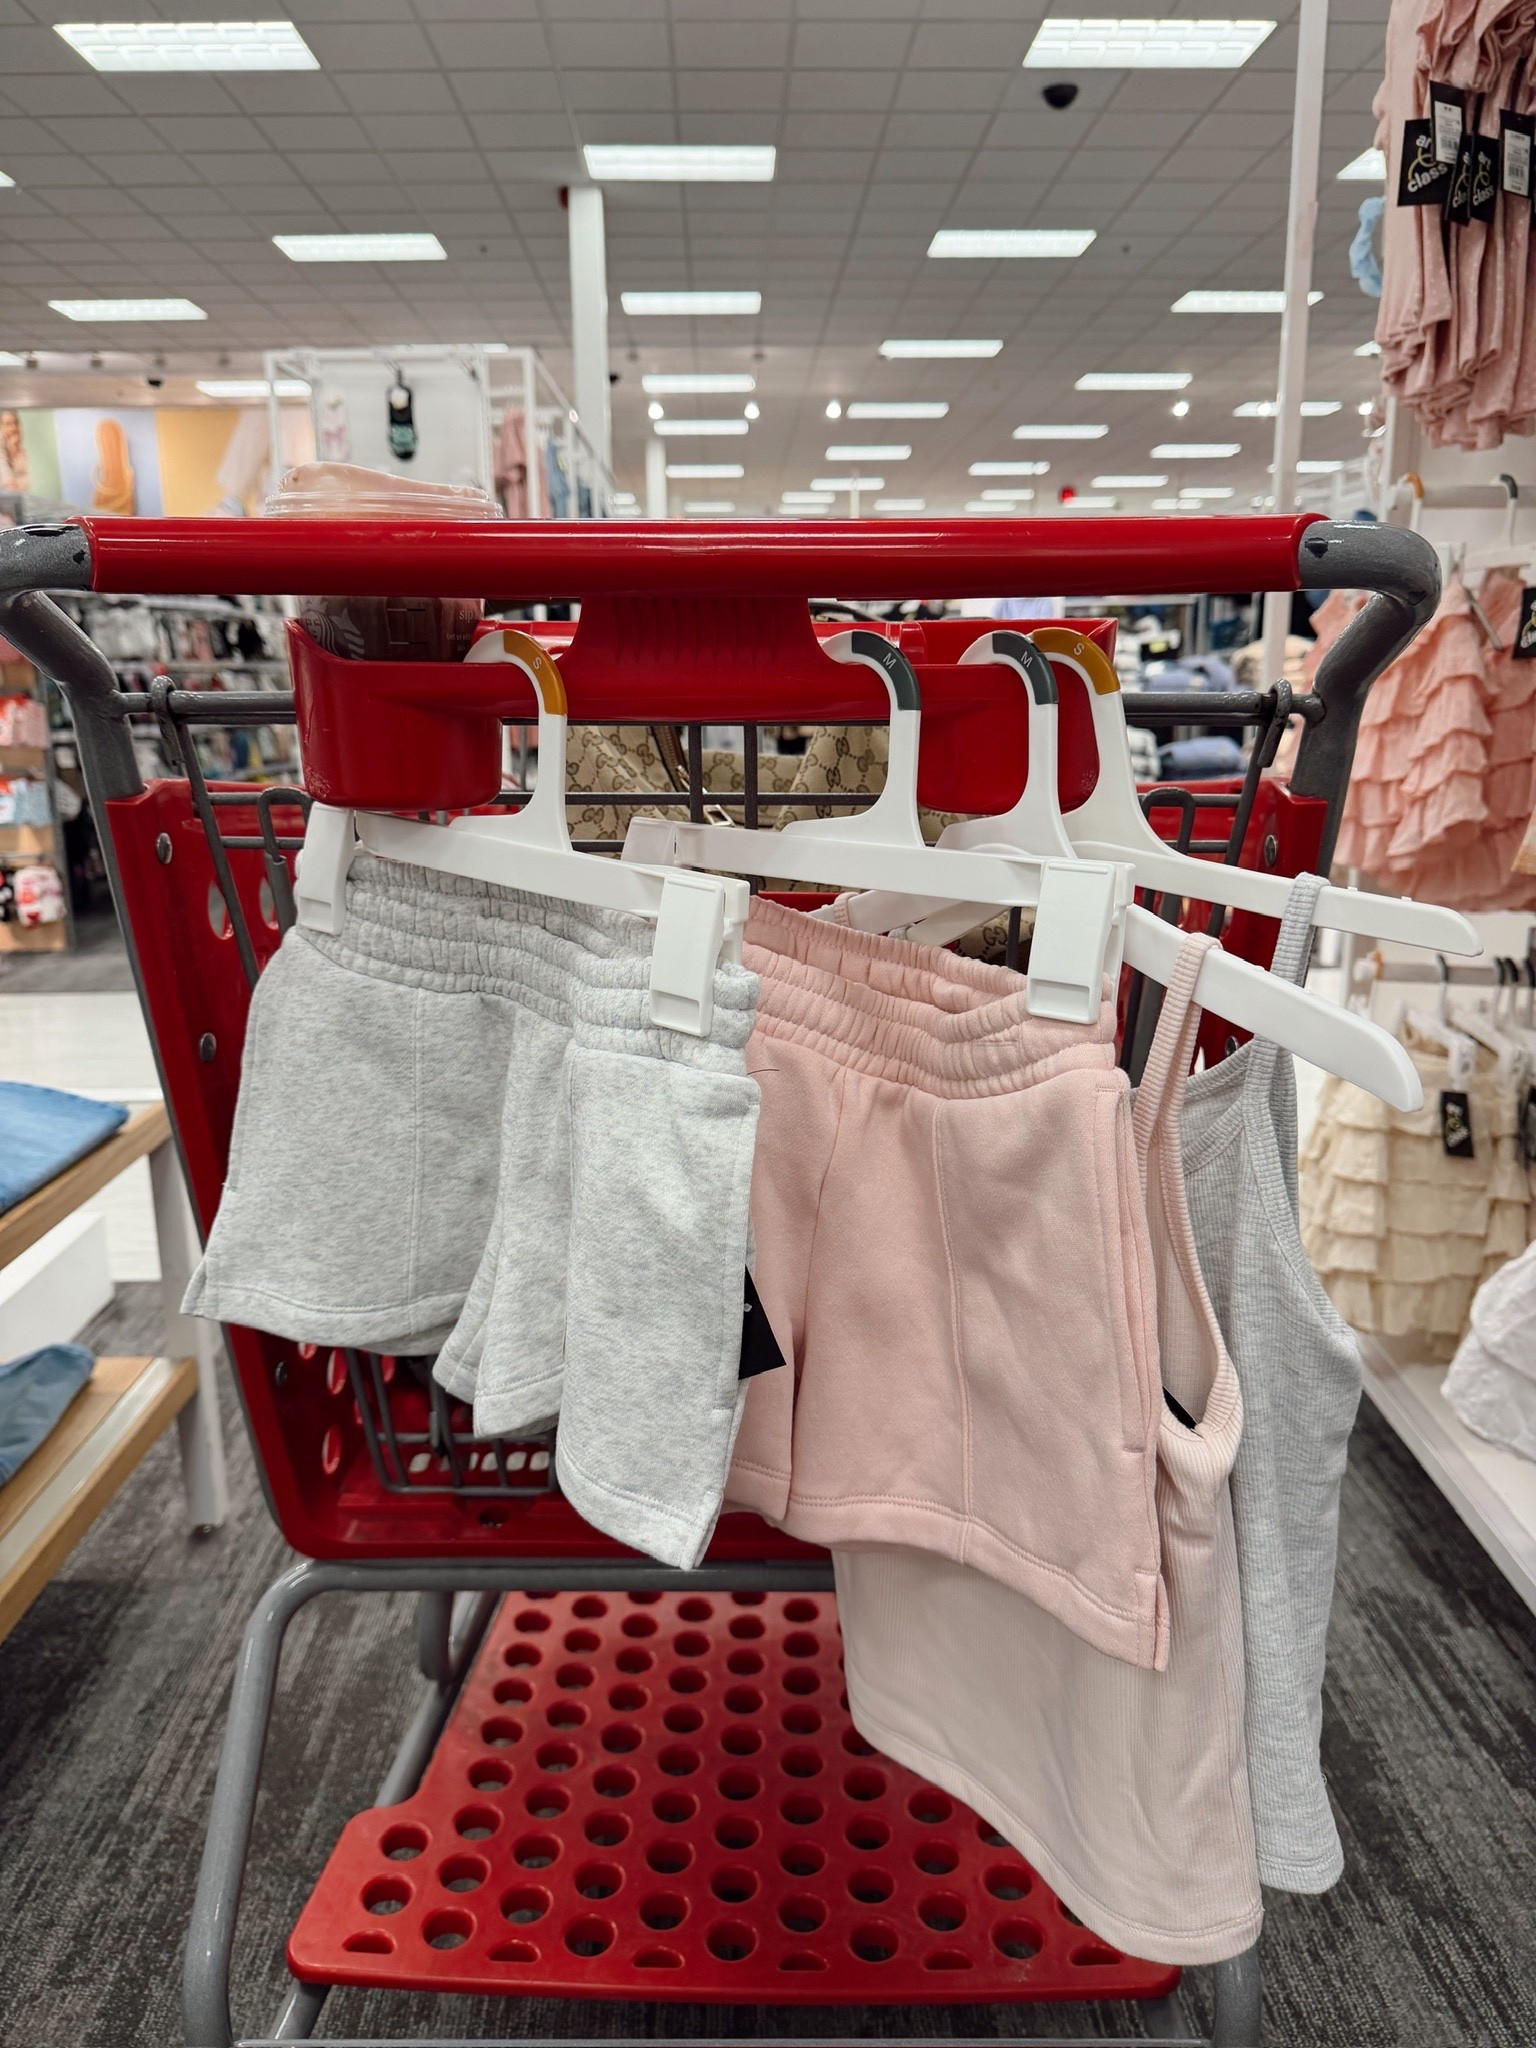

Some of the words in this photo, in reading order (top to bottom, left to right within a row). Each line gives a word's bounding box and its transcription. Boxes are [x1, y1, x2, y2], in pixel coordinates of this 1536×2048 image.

[1415, 134, 1432, 149] ar
[1407, 163, 1448, 193] class
[1073, 642, 1085, 655] S
[532, 656, 542, 670] S
[882, 652, 897, 669] M
[1020, 651, 1033, 668] M
